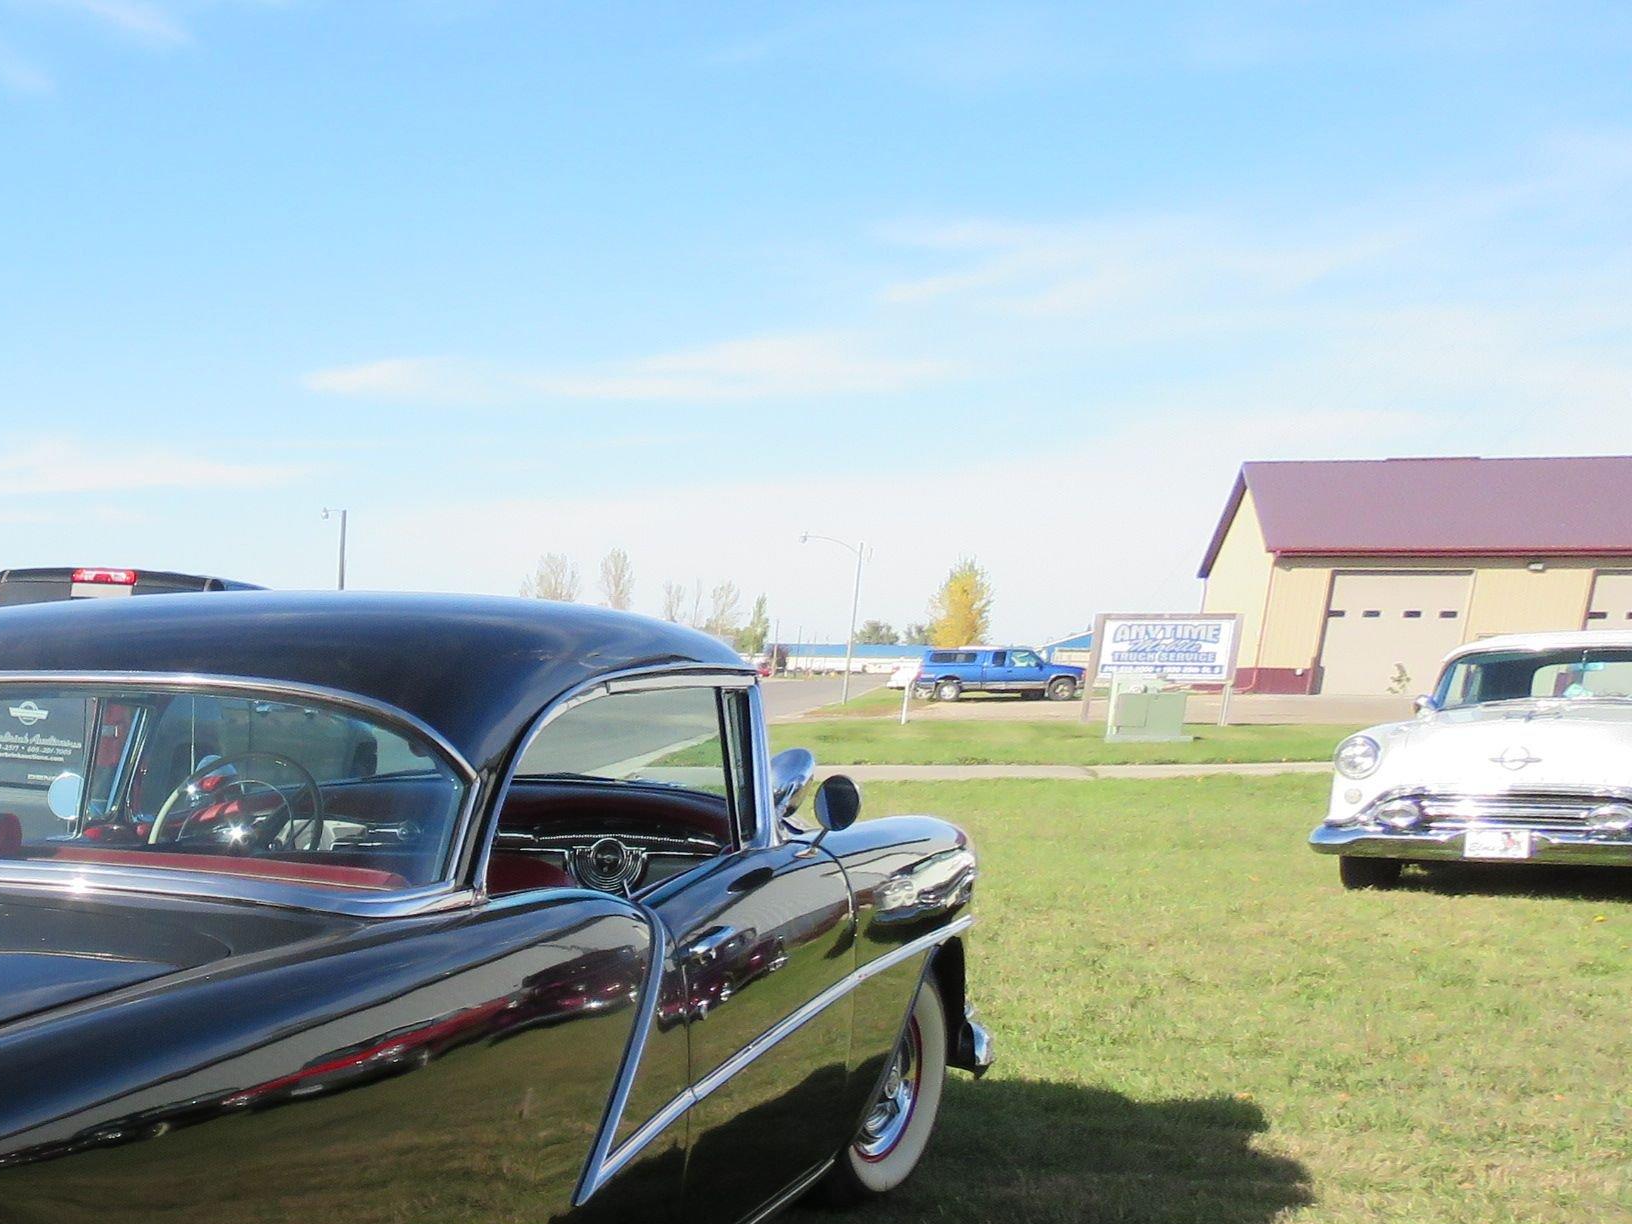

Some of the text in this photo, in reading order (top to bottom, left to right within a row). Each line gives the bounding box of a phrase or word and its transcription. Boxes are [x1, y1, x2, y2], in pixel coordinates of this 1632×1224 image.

[1113, 624, 1221, 643] ANYTIME
[1112, 651, 1217, 663] TRUCK SERVICE
